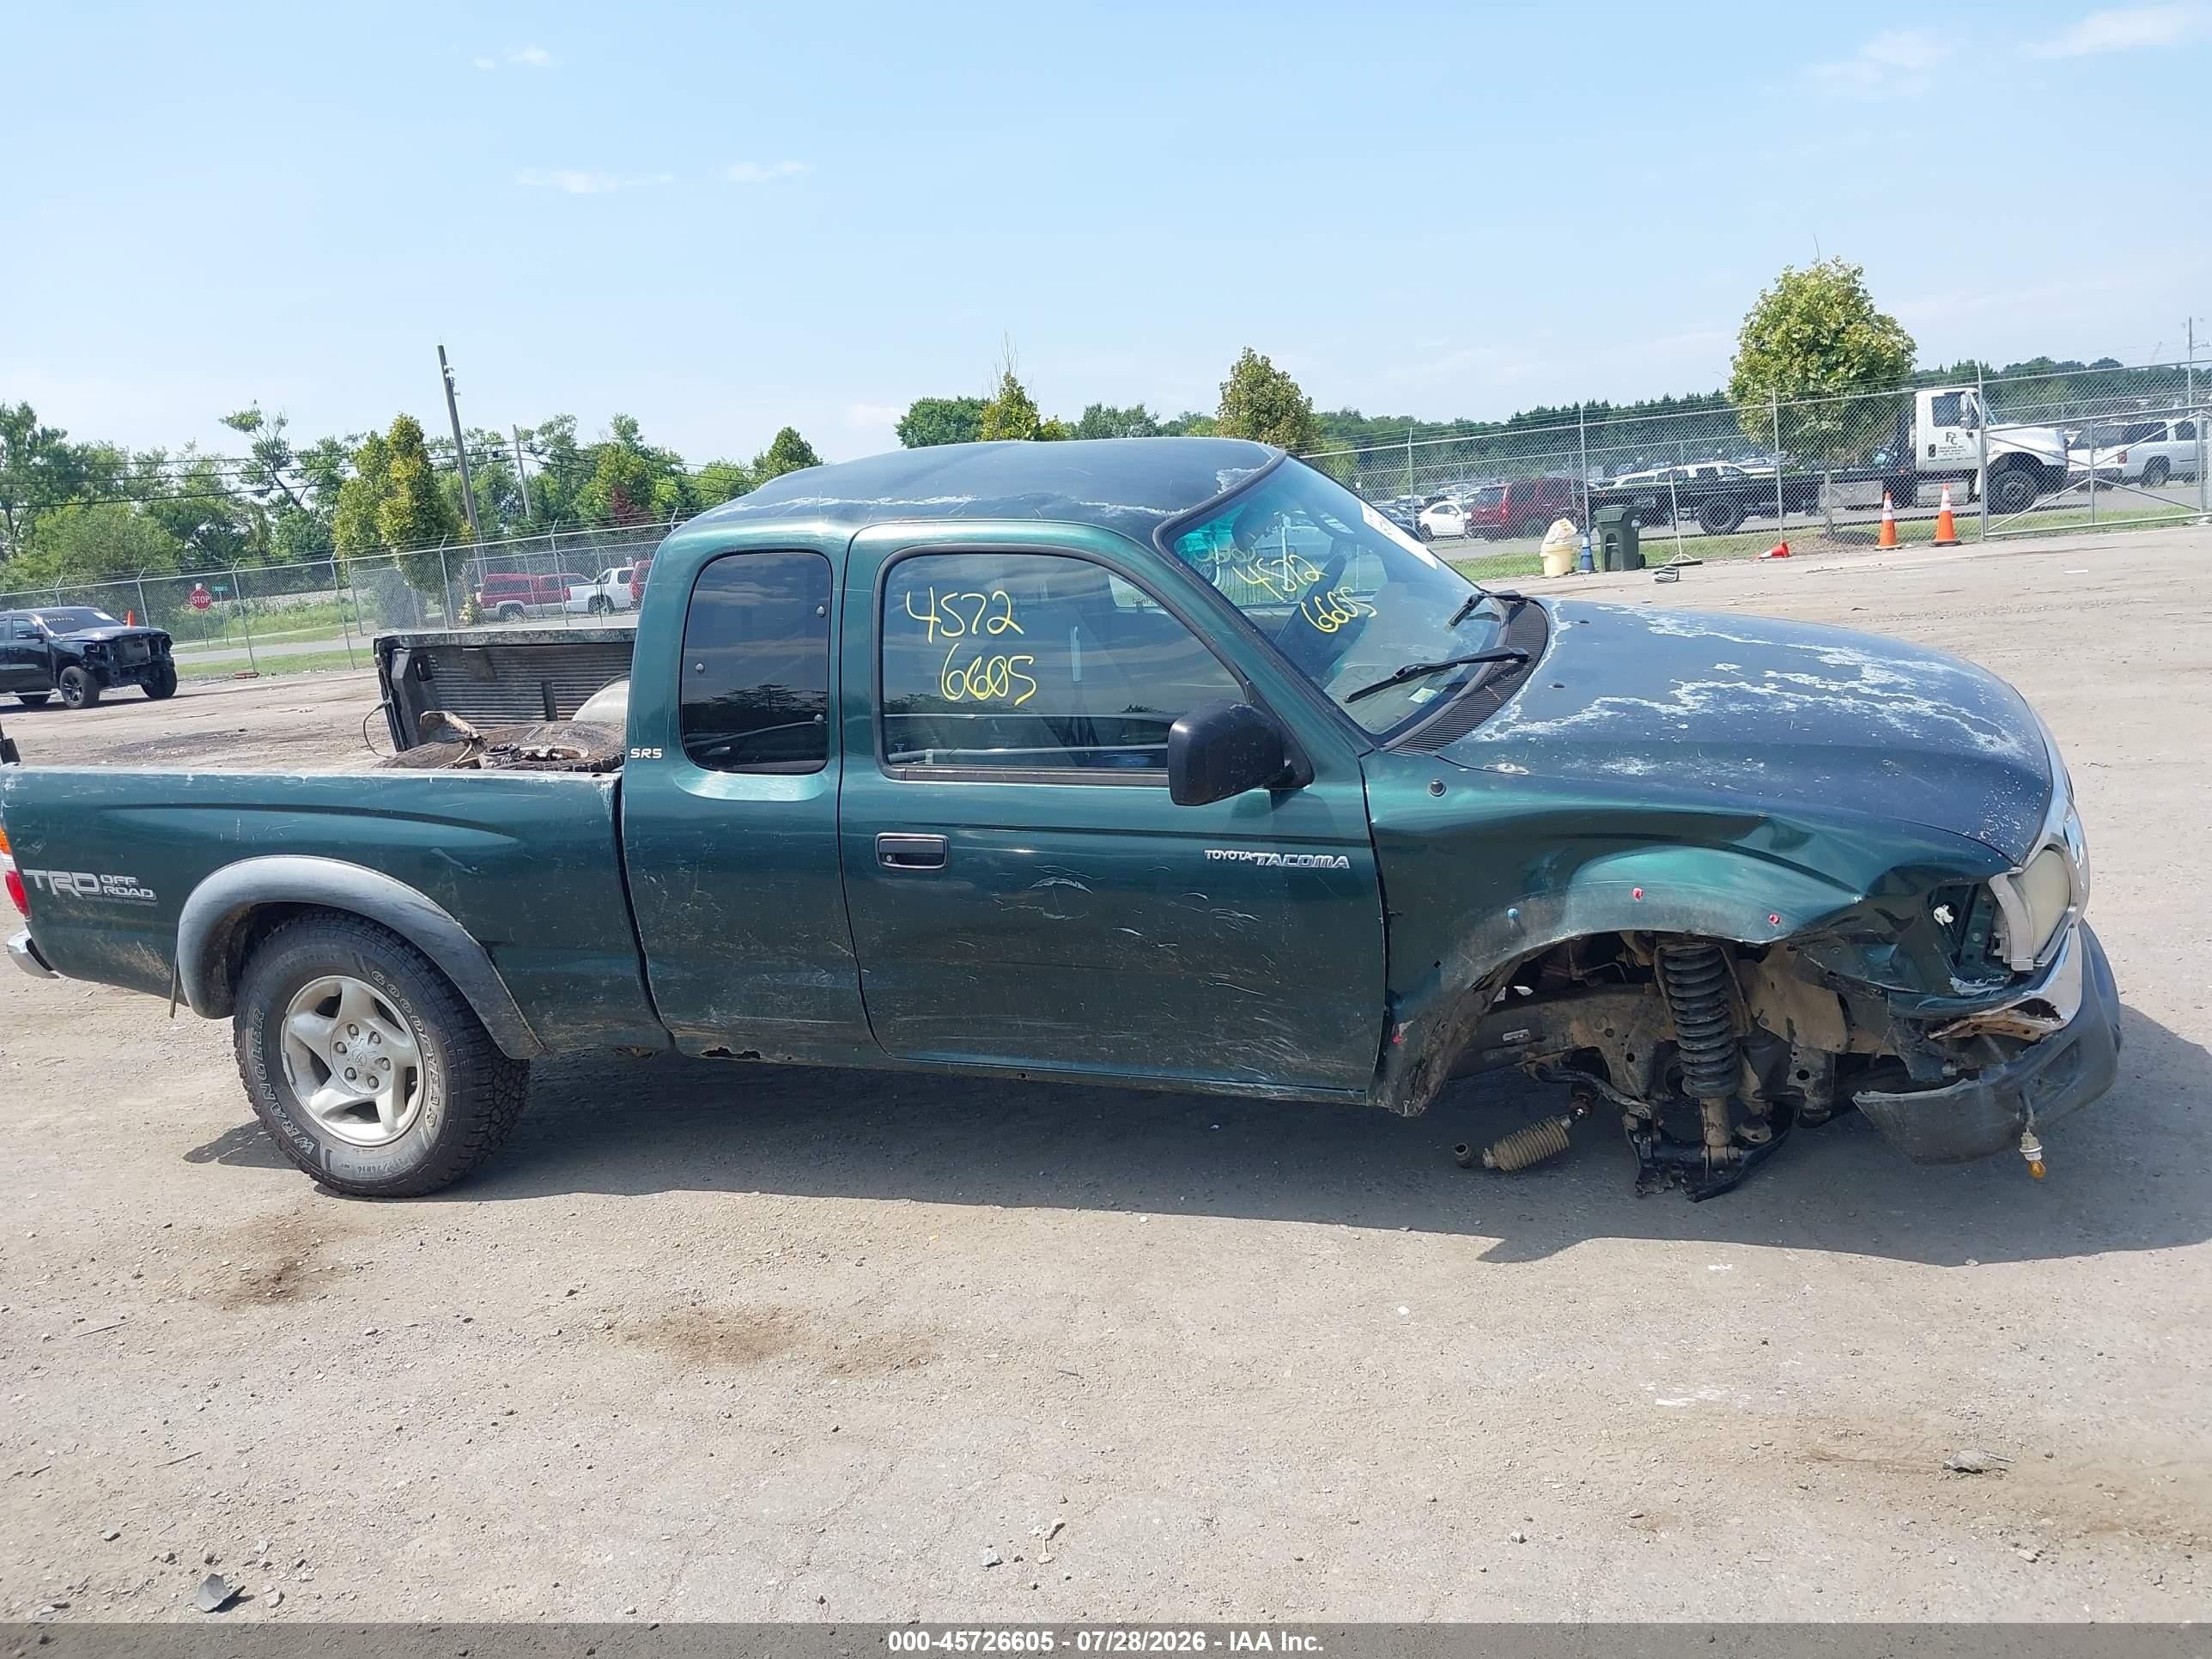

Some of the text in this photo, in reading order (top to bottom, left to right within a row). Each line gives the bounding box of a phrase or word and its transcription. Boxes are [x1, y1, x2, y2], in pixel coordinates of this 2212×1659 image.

[191, 595, 210, 605] STOP
[1231, 554, 1330, 601] 4572
[905, 586, 1024, 645] 4572
[1300, 586, 1378, 633] 6605
[941, 642, 1037, 706] 6605
[629, 748, 663, 759] SR5
[1204, 849, 1350, 869] TOYOTA TACOMA
[21, 868, 137, 898] TRD OFF
[102, 885, 155, 899] ROAD
[371, 970, 442, 1127] GOODYEAR
[250, 1008, 316, 1154] WRANGLER
